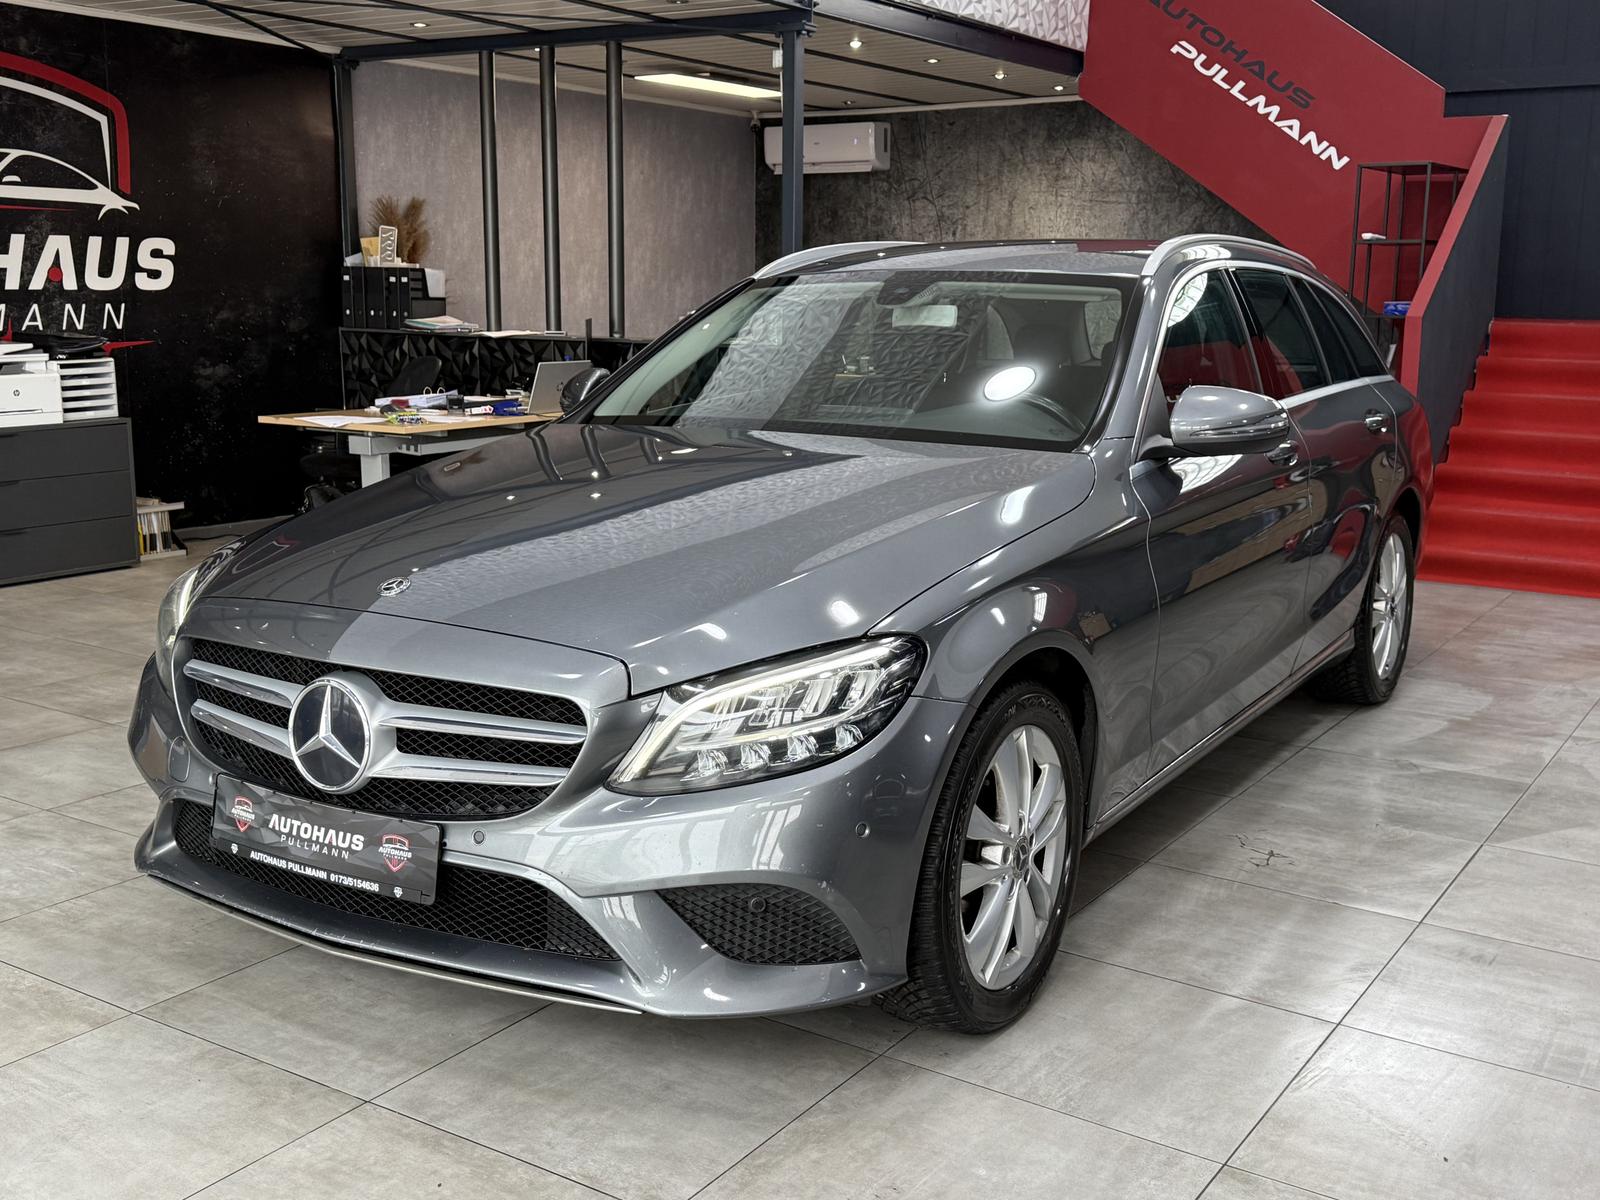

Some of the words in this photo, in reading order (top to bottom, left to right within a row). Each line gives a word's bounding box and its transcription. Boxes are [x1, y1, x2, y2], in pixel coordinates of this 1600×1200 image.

[1170, 40, 1350, 170] PULLMANN
[0, 303, 126, 331] ANN
[268, 813, 365, 851] AUTOHAUS
[280, 834, 349, 859] PULLMANN
[378, 846, 412, 858] AUTOHAUS
[250, 850, 287, 869] AUTOHAUS
[287, 861, 328, 880] PULLMANN
[329, 873, 380, 892] 0173/5154636
